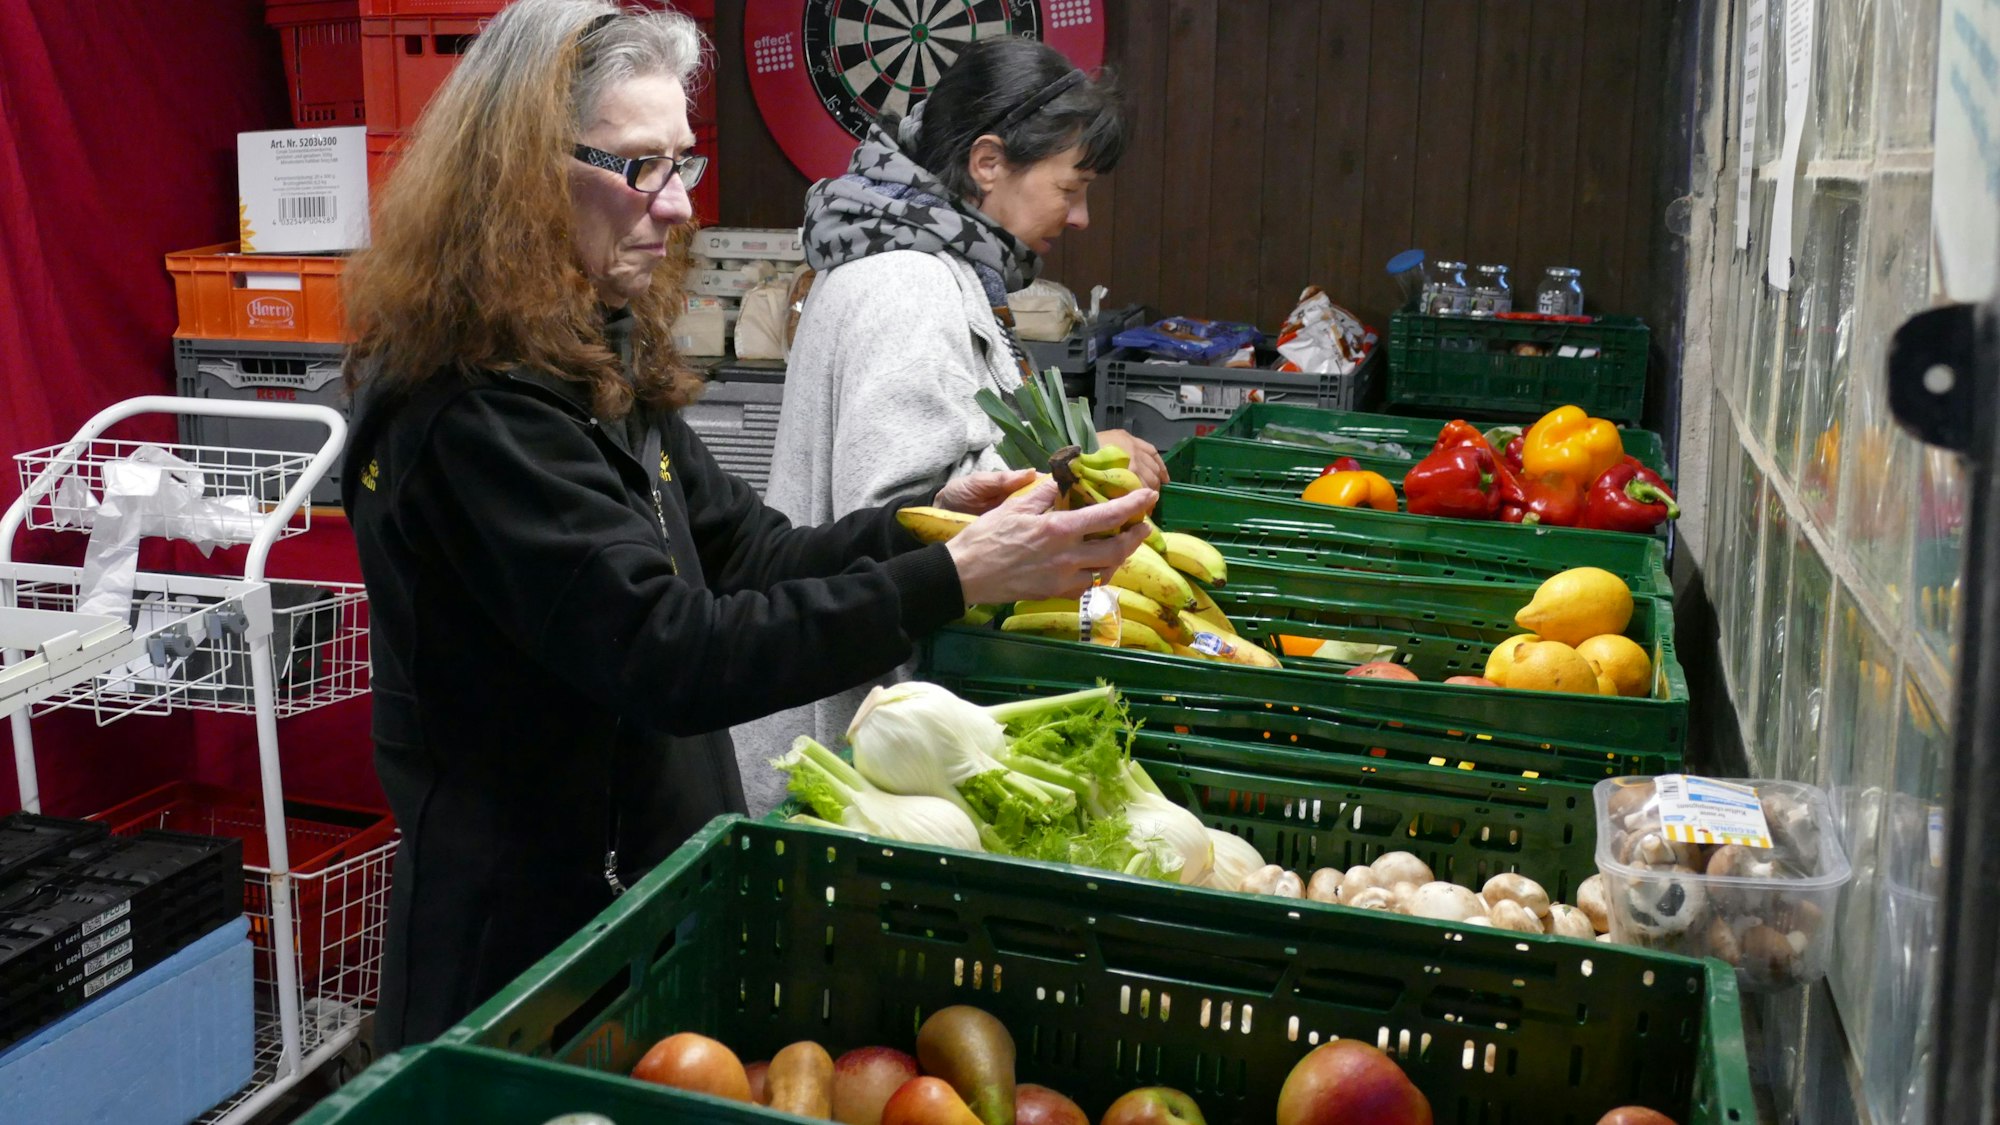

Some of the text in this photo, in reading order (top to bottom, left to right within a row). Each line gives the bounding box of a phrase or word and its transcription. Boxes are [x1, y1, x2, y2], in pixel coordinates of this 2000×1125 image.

[270, 139, 285, 149] Art.
[286, 138, 298, 148] Nr.
[256, 387, 297, 401] REWE
